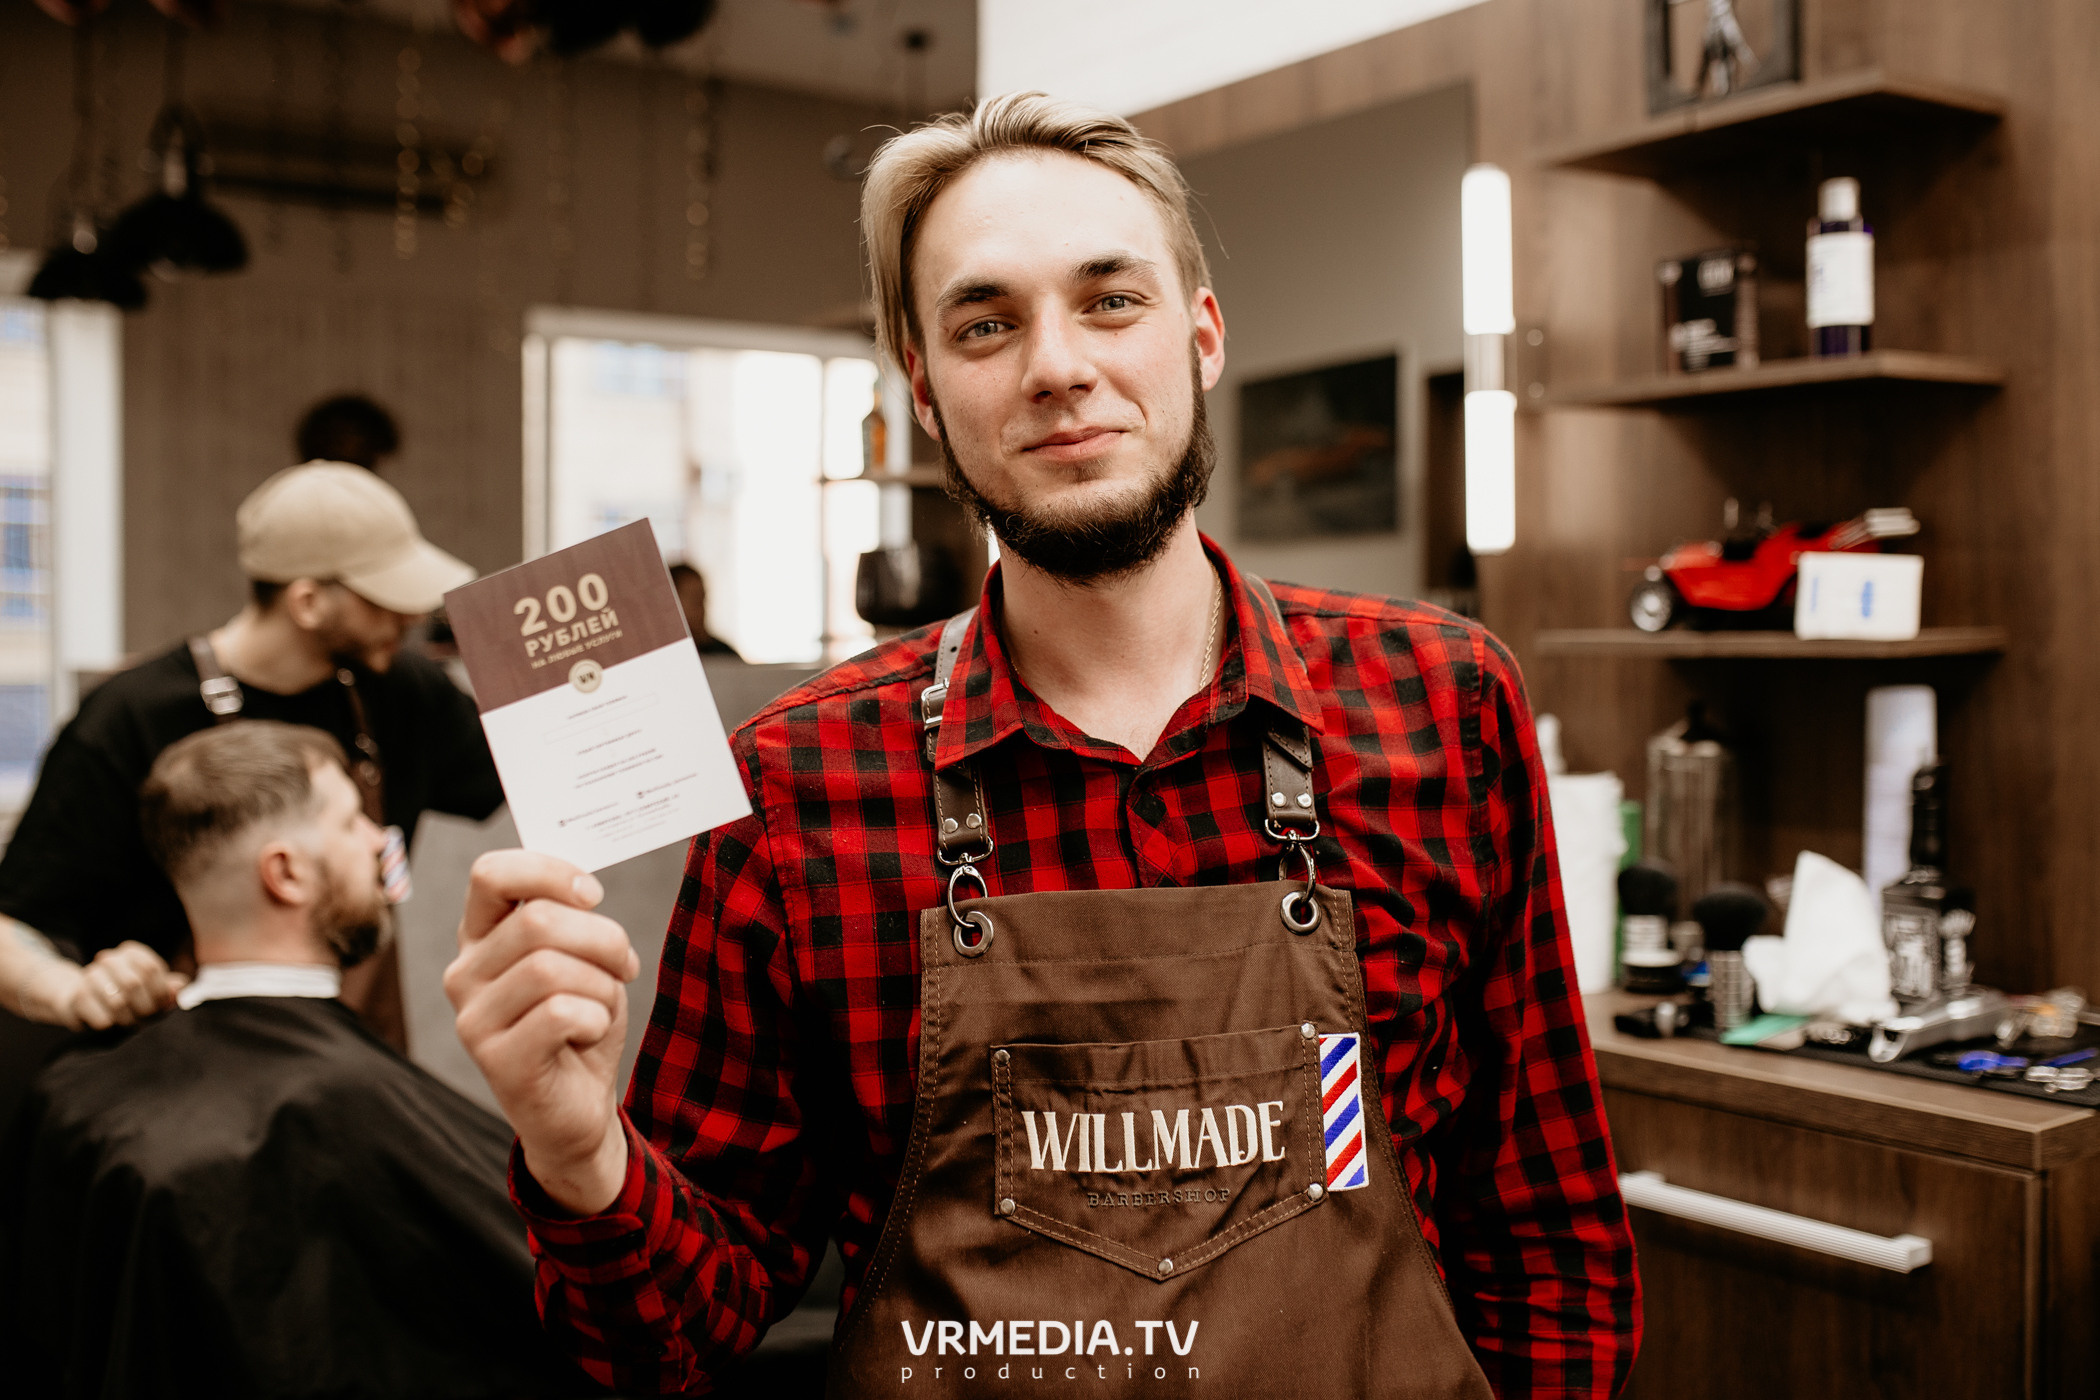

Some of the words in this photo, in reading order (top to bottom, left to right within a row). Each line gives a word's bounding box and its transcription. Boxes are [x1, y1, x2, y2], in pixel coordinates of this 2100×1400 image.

[513, 573, 609, 636] 200
[524, 607, 619, 658] РУБЛЕЙ
[1021, 1100, 1286, 1173] WILLMADE
[1087, 1188, 1231, 1208] BARBERSHOP
